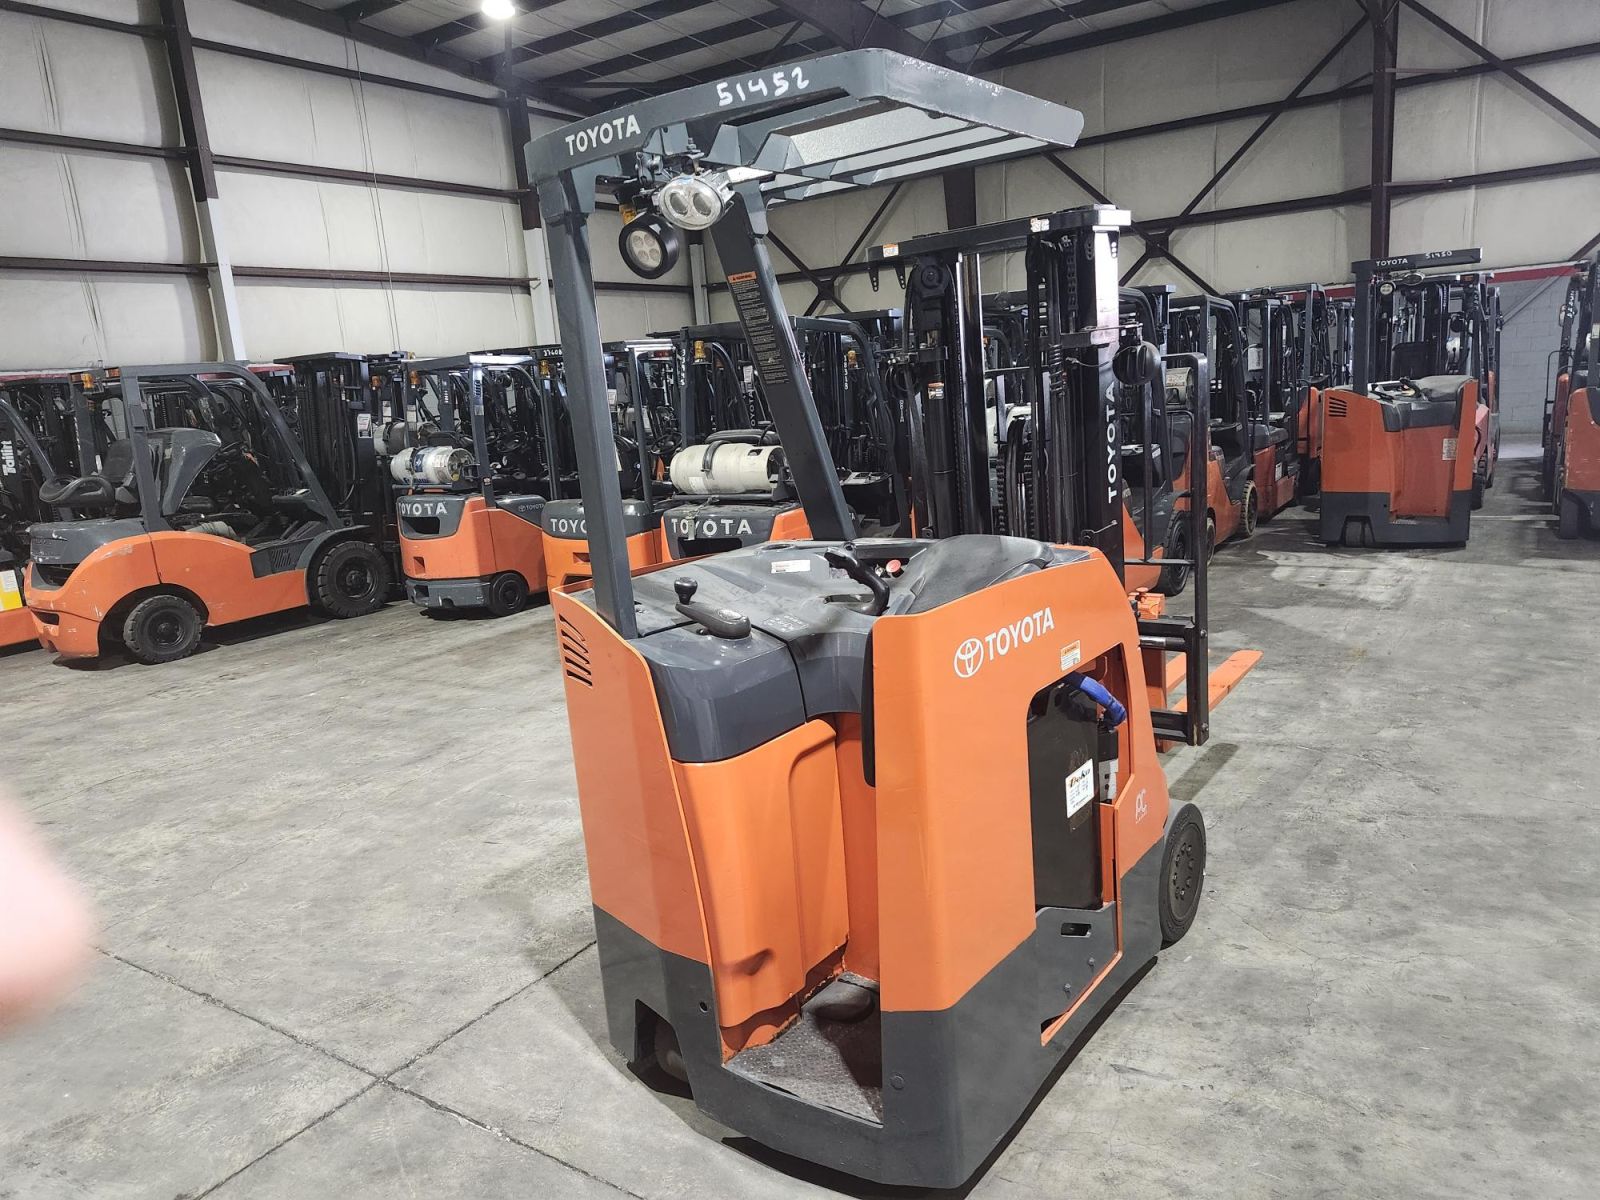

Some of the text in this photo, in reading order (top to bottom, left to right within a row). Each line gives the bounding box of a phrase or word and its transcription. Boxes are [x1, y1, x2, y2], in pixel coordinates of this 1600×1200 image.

[716, 66, 810, 107] 51452
[565, 114, 641, 156] TOYOTA
[1376, 258, 1408, 266] TOYOTA
[747, 389, 756, 427] OYOTA
[1105, 381, 1117, 504] TOYOTA
[550, 518, 588, 534] TOYO
[985, 607, 1055, 660] TOYOTA
